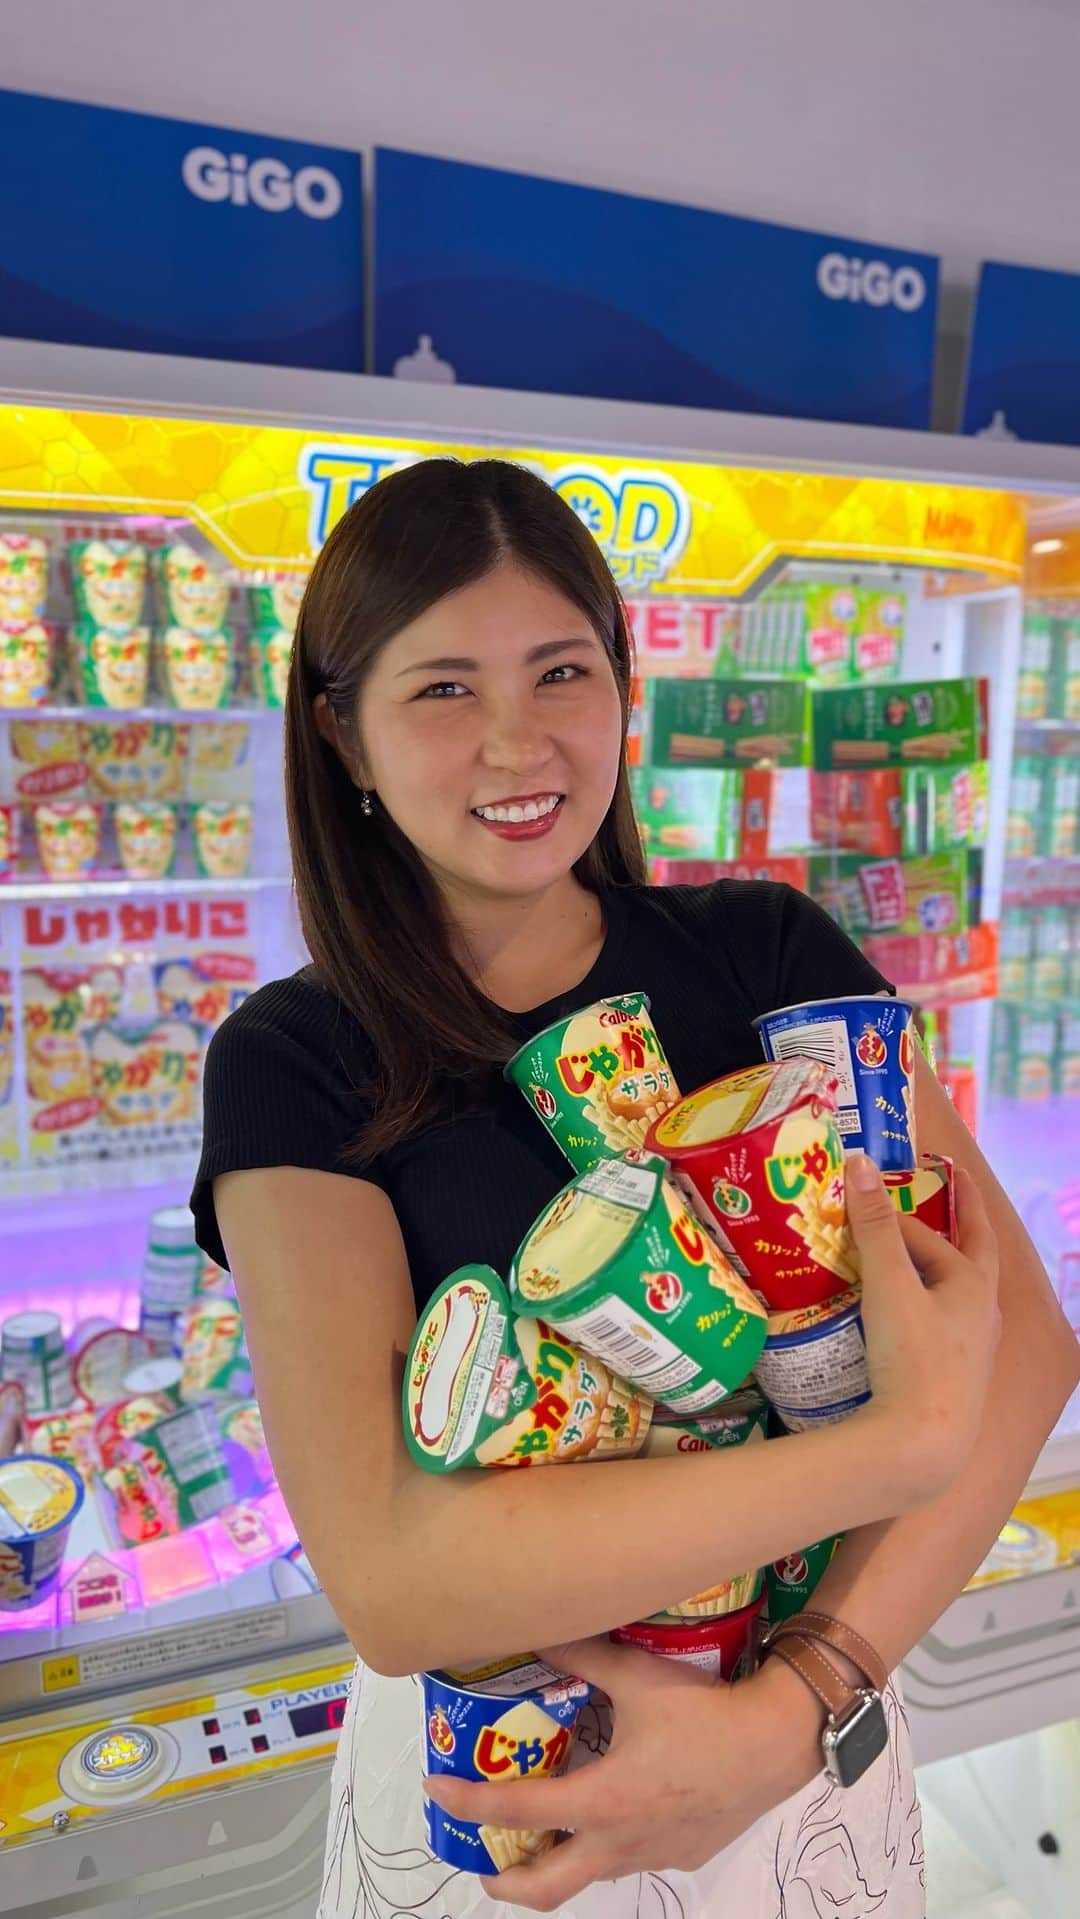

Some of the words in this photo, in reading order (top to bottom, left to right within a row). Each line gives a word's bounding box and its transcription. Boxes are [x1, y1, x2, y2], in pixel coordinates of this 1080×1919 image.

[182, 147, 342, 219] GiGO
[817, 253, 925, 311] GiGO
[621, 1071, 671, 1100] サラダ
